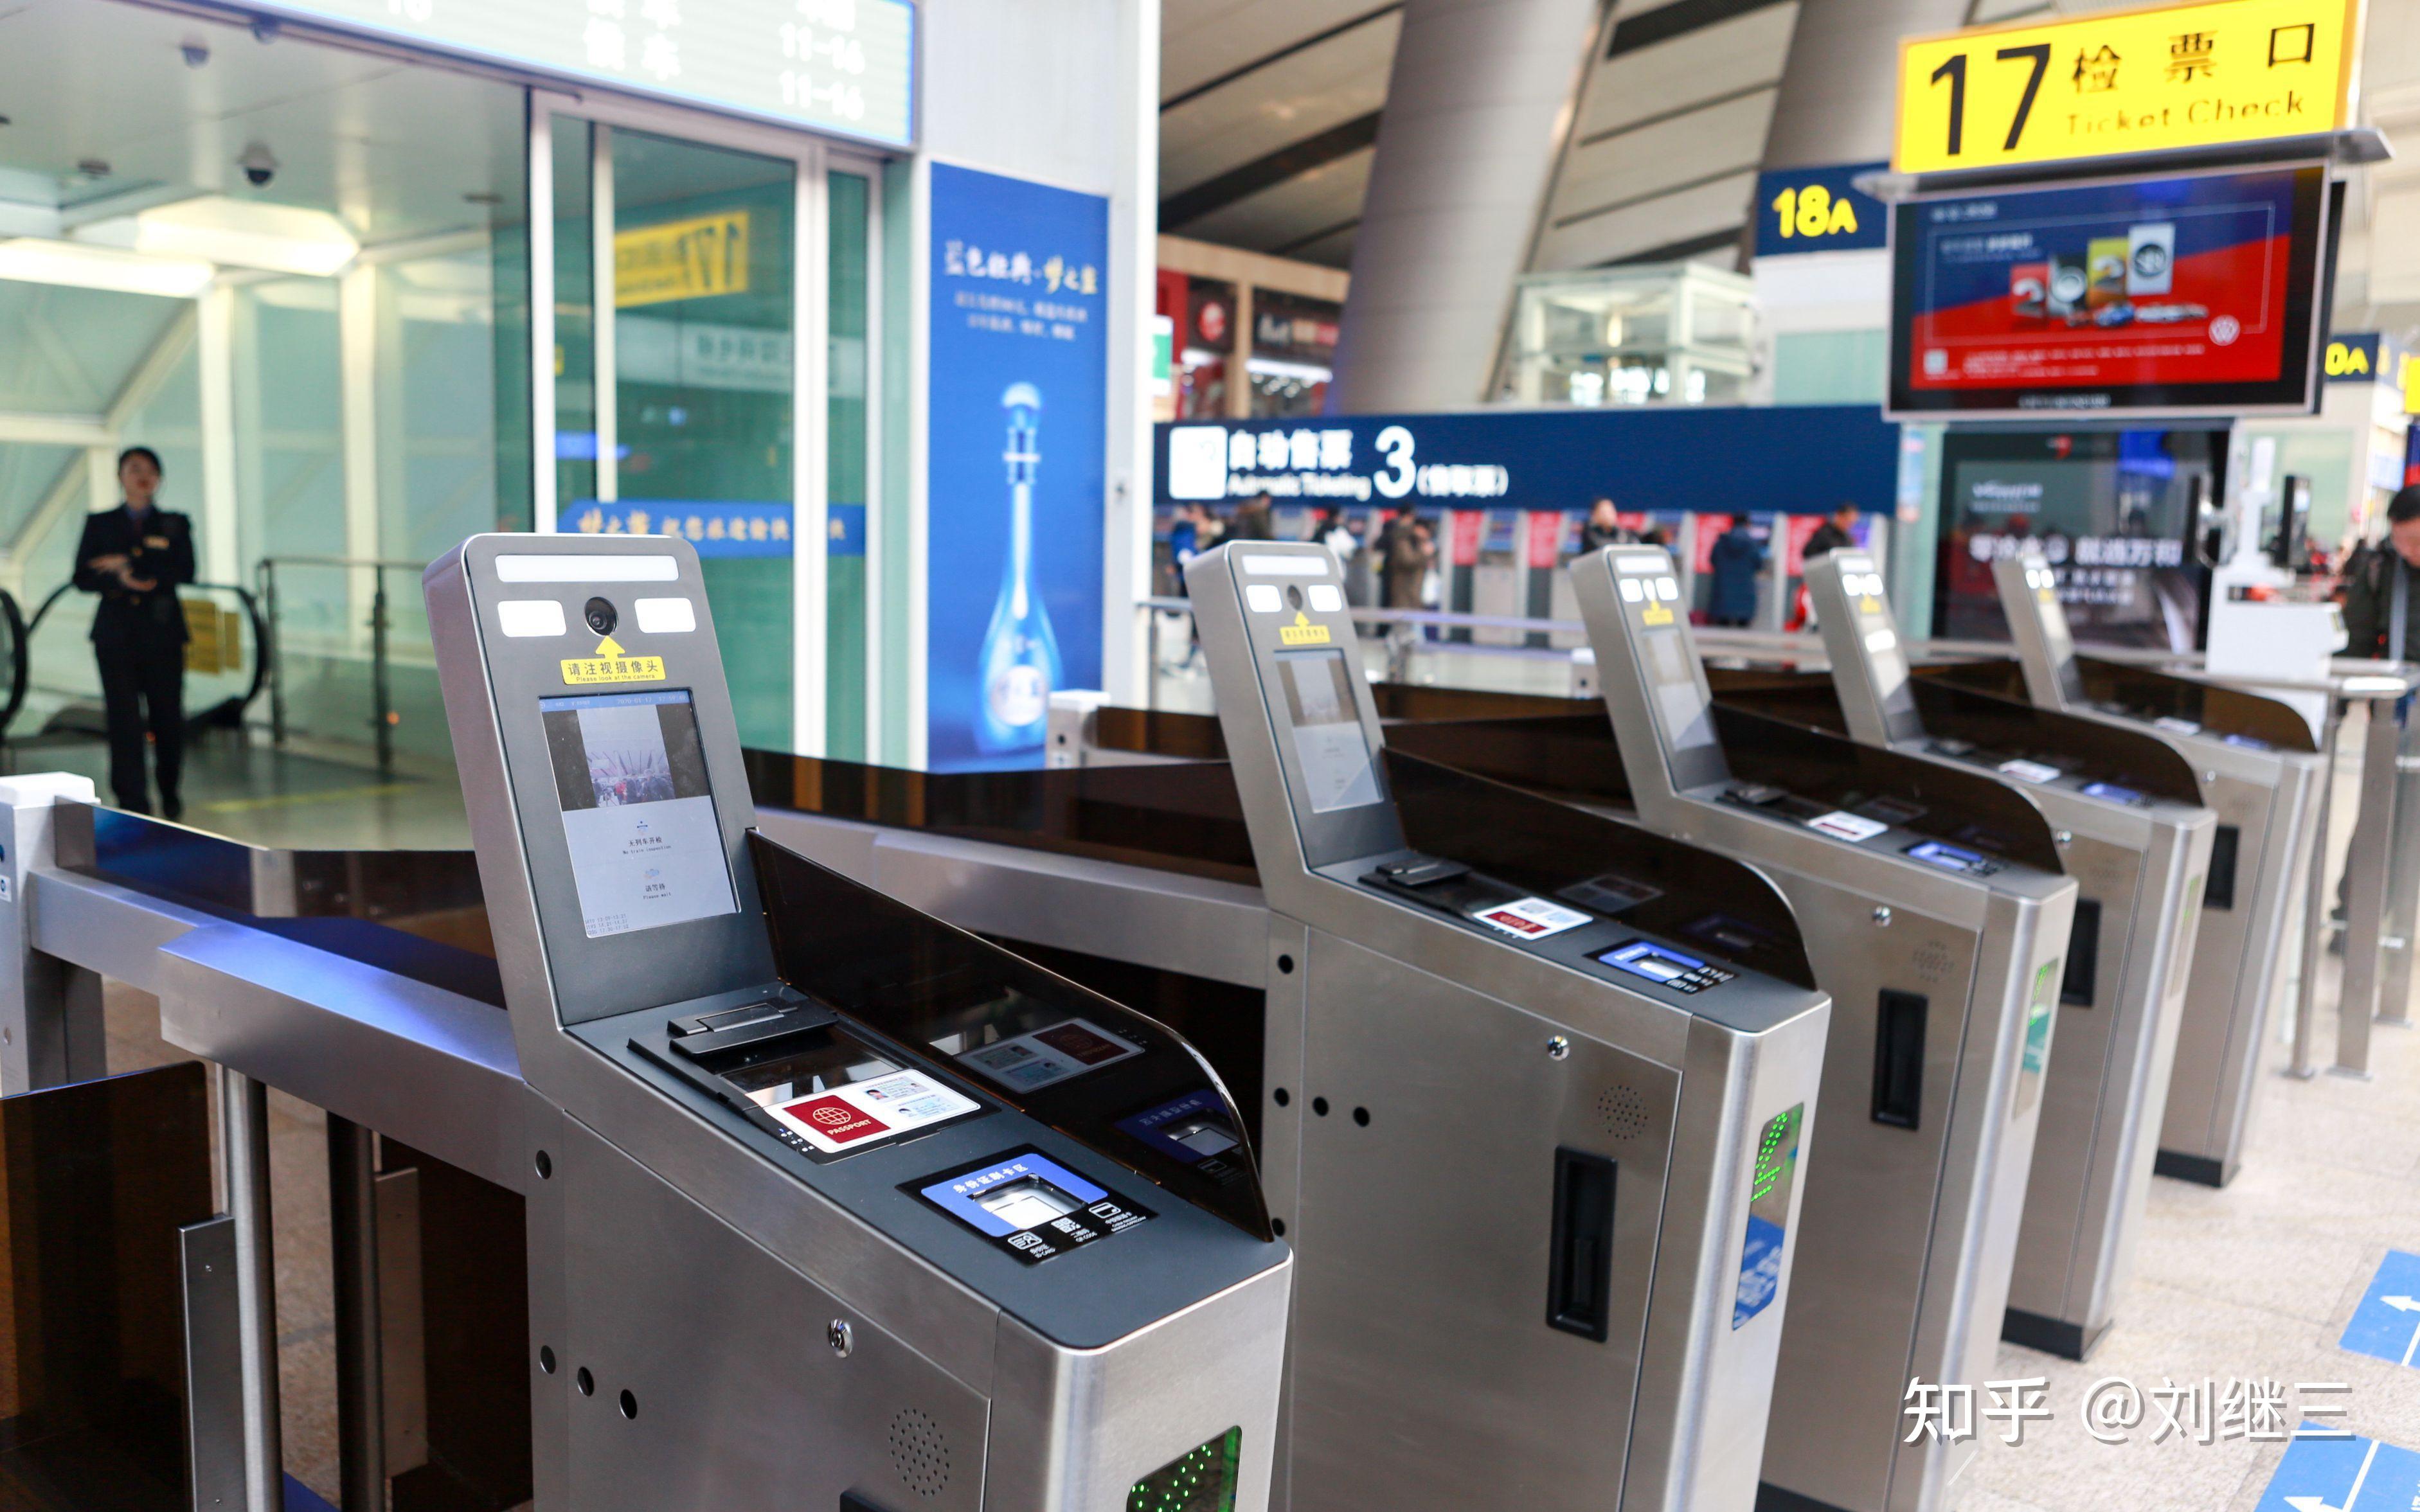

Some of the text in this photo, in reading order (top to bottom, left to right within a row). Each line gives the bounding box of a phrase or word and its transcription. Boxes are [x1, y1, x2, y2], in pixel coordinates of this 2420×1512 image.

[2072, 23, 2315, 94] 检票口
[1931, 43, 2051, 156] 17
[2067, 90, 2303, 135] Ticket Check
[1771, 184, 1858, 238] 18A
[1374, 425, 1415, 499] 3
[568, 660, 658, 675] 请注视摄像头
[827, 1119, 871, 1135] PASSPORT
